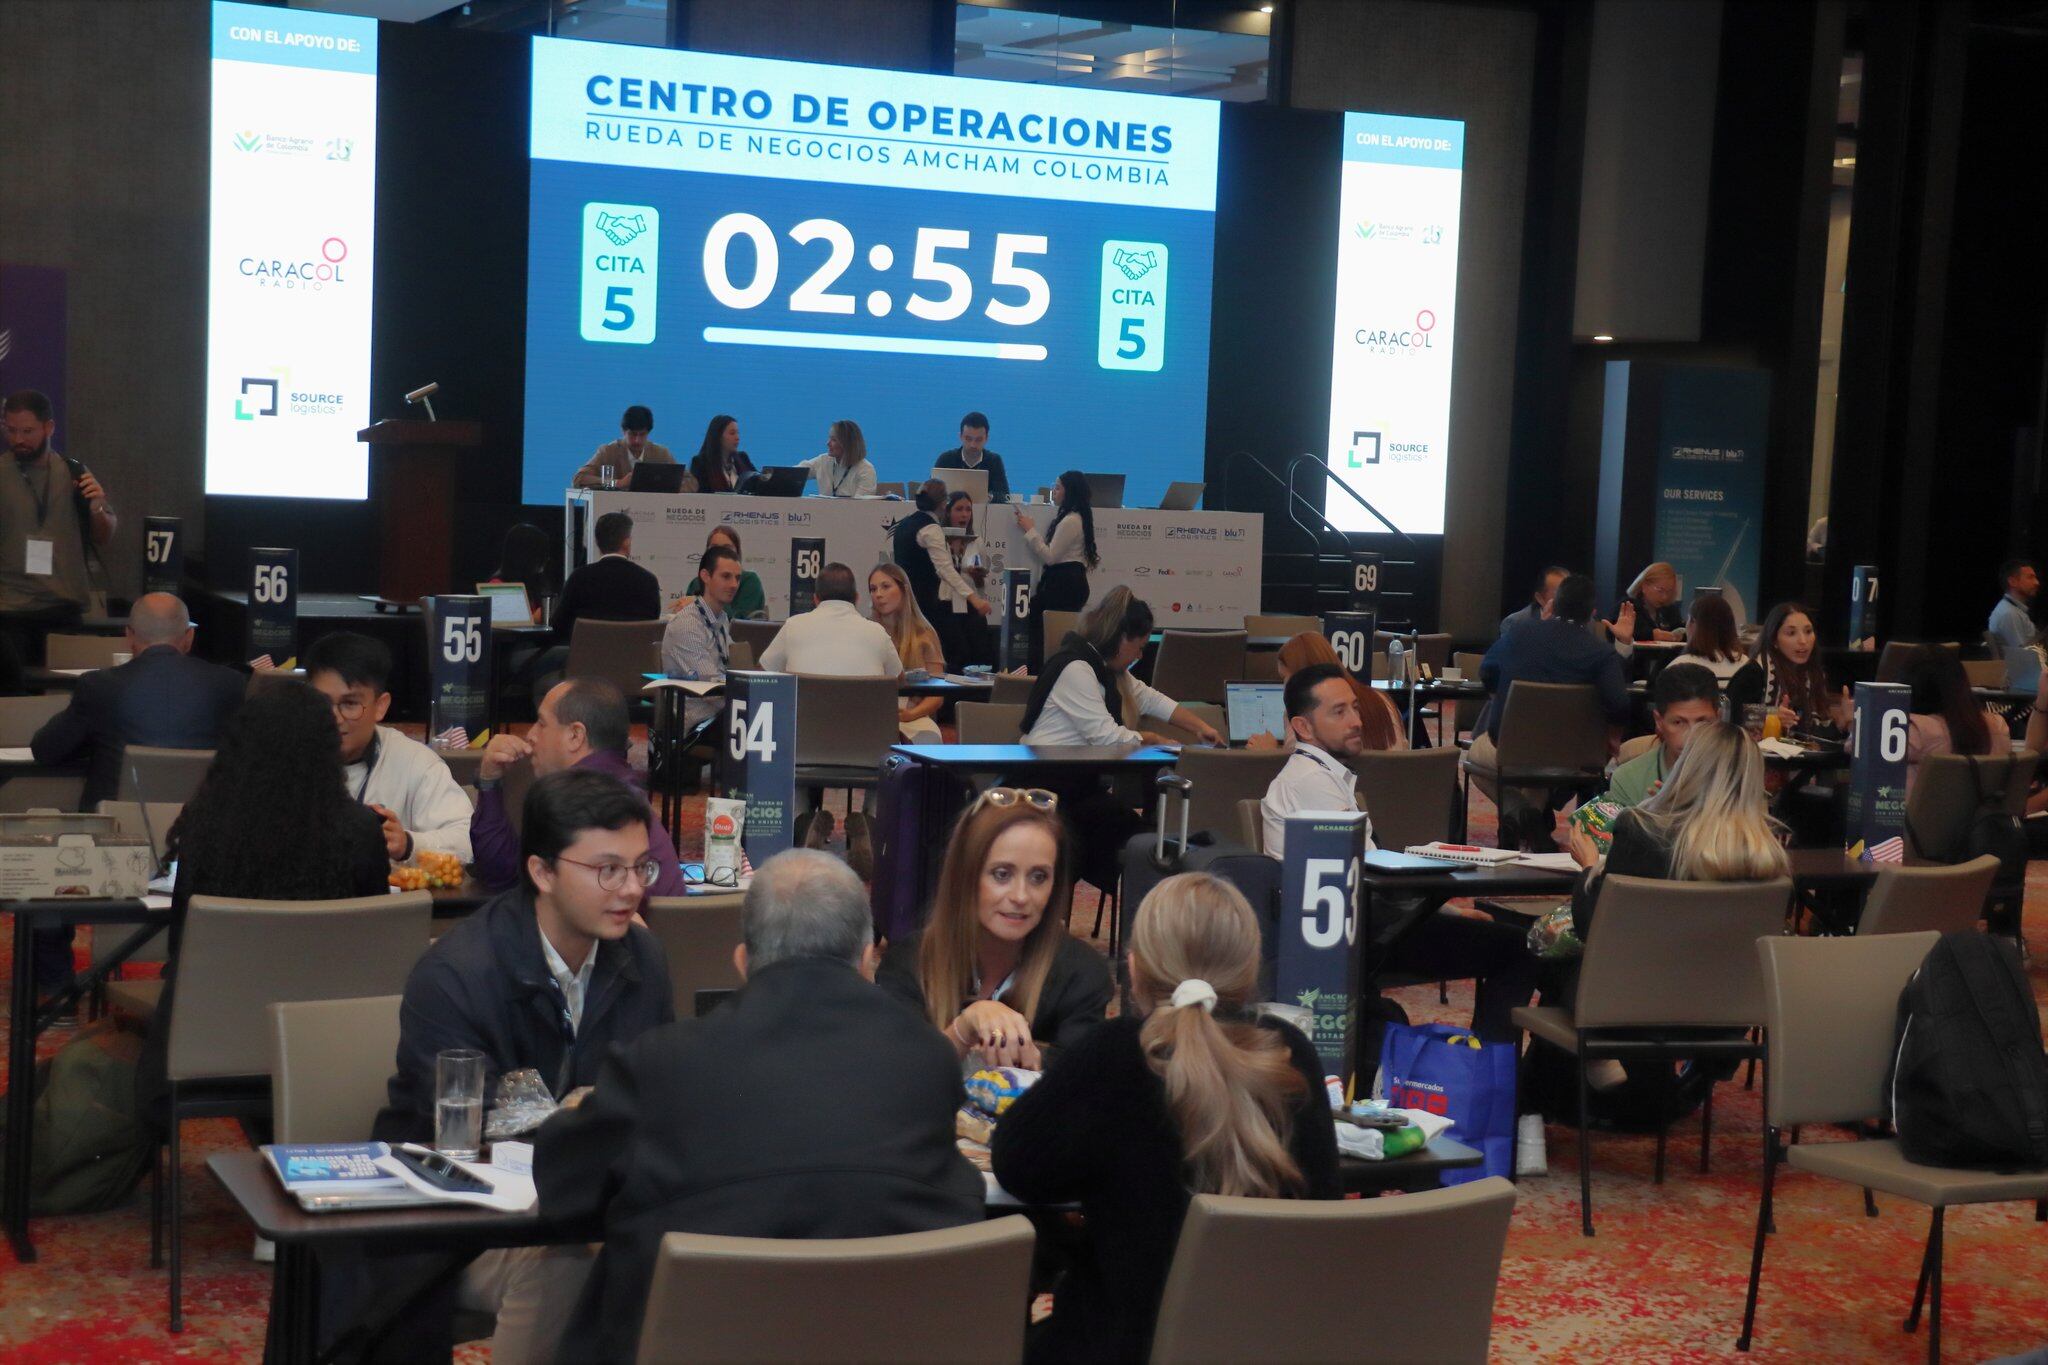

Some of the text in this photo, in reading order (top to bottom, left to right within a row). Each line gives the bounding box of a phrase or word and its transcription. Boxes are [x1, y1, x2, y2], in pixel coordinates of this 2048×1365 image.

[230, 26, 361, 53] CON EL APOYO DE:
[586, 75, 1172, 154] CENTRO DE OPERACIONES
[586, 121, 1169, 186] RUEDA DE NEGOCIOS AMCHAM COLOMBIA
[1356, 133, 1451, 151] CON EL APOYO DE:
[239, 258, 344, 282] CARACOL
[595, 254, 645, 274] CITA
[703, 212, 1051, 326] 02:55
[260, 278, 322, 291] RADIO
[602, 287, 635, 331] 5
[1111, 289, 1155, 306] CITA
[1116, 318, 1146, 360] 5
[1355, 329, 1432, 348] CARACOL
[1370, 346, 1415, 356] RADIO
[290, 403, 335, 415] logistics
[291, 392, 343, 404] SOURCE
[1389, 443, 1428, 453] SOURCE
[1664, 489, 1723, 500] OUR SERVICES
[667, 515, 706, 523] NEGOCIOS
[734, 511, 779, 519] RHENUS
[1176, 527, 1217, 535] RHENUS
[147, 531, 174, 562] 57
[797, 549, 820, 579] 58
[255, 565, 287, 603] 56
[1355, 564, 1377, 592] 69
[443, 616, 482, 663] 55
[1331, 630, 1364, 672] 60
[730, 699, 777, 762] 54
[1301, 856, 1360, 948] 53
